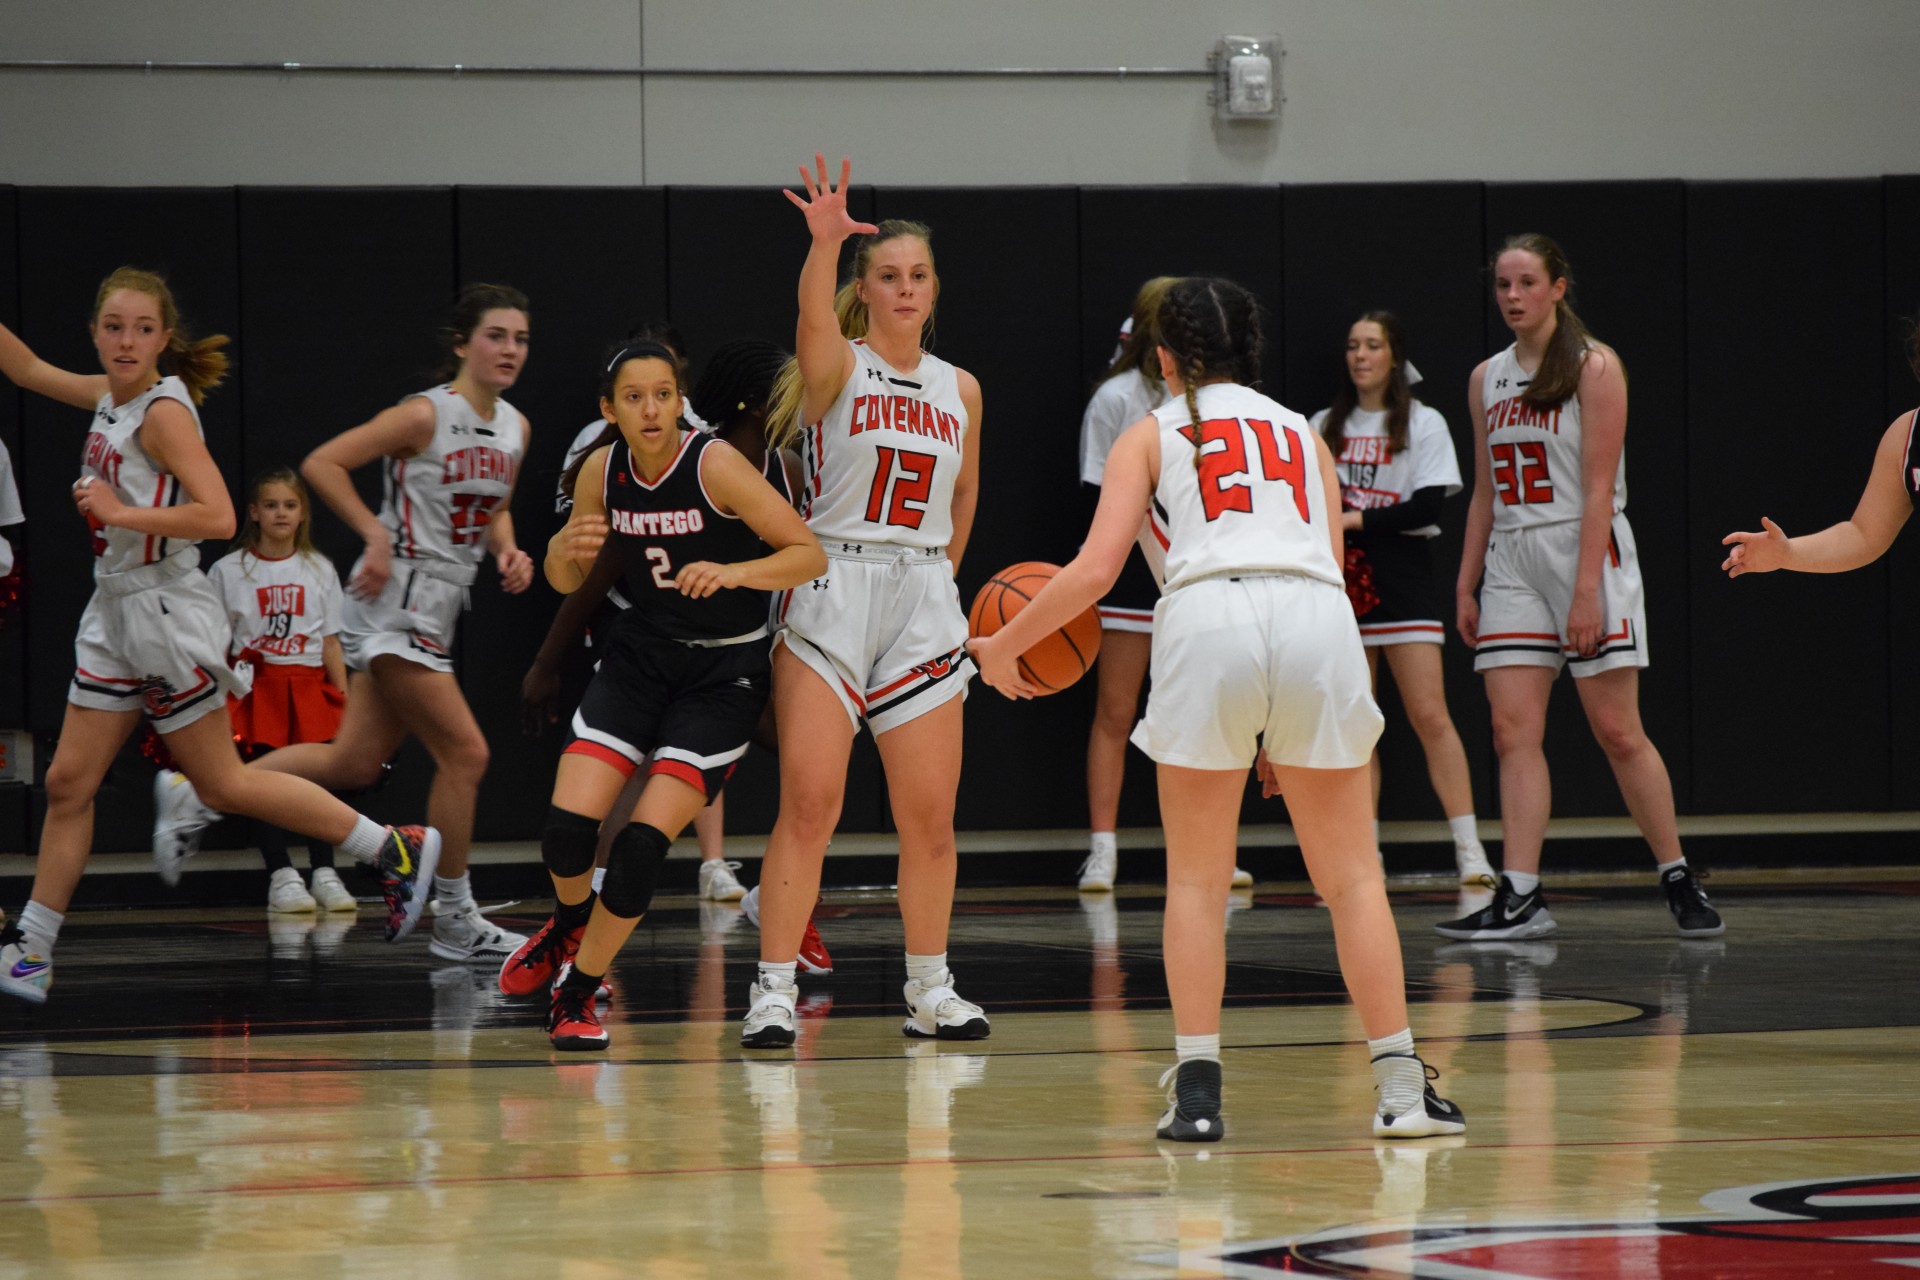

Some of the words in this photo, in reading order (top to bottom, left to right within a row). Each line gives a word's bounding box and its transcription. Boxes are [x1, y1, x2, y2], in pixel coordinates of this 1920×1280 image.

[849, 394, 960, 454] COVENANT
[1176, 417, 1311, 525] 24
[1340, 437, 1388, 463] JUST
[864, 445, 938, 531] 12
[1350, 464, 1375, 489] US
[1490, 441, 1555, 506] 32
[611, 508, 704, 536] PANTEGO
[645, 546, 676, 588] 2
[264, 586, 300, 614] JUST
